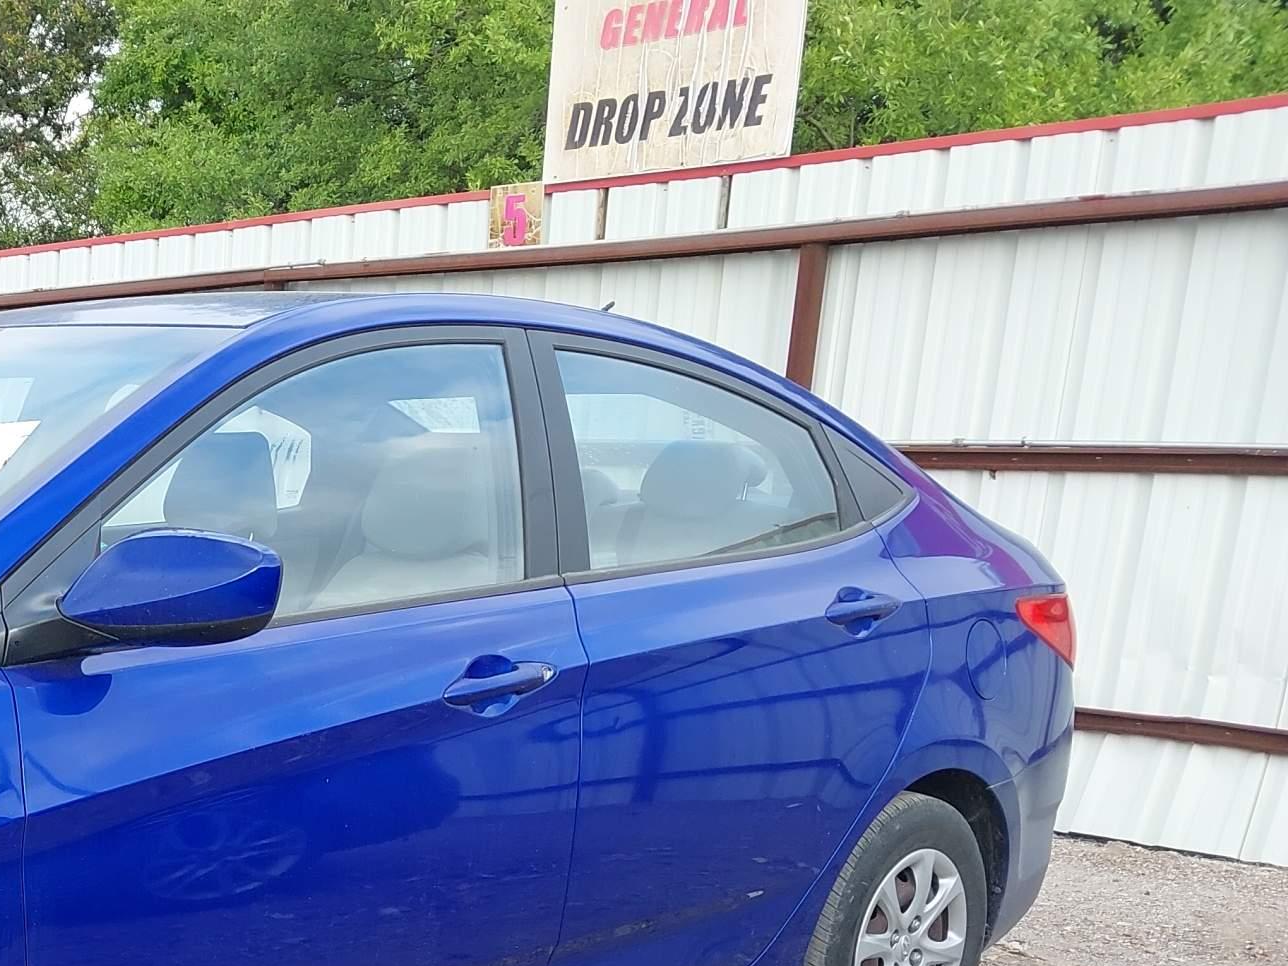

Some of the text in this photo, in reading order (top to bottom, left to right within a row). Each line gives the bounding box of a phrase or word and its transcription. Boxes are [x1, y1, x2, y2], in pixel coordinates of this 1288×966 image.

[600, 0, 748, 50] GENERAL
[564, 73, 774, 151] DROP ZONE
[503, 193, 527, 247] 5
